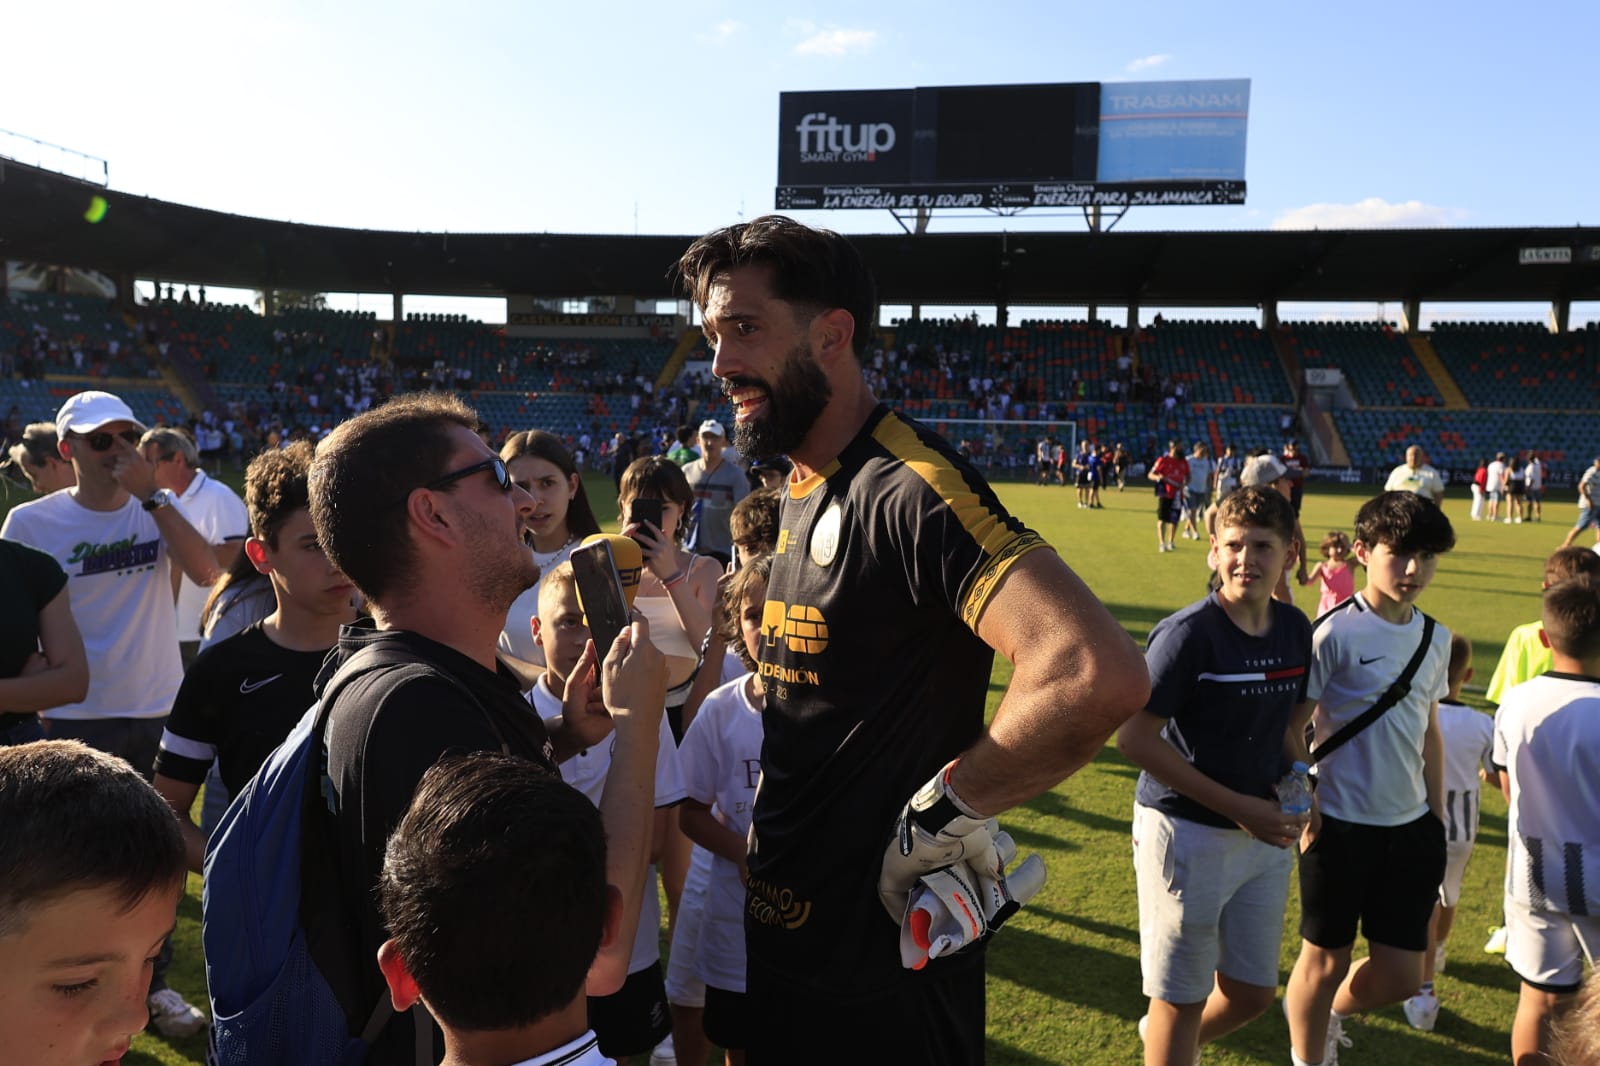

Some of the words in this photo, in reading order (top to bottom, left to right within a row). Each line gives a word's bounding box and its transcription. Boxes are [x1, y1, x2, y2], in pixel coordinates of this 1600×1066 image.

[1109, 93, 1241, 111] TRASANAM
[796, 112, 896, 153] fitup
[800, 151, 840, 163] SMART
[842, 151, 868, 162] GYM
[823, 195, 841, 209] LA
[841, 191, 896, 209] ENERGÍA
[898, 194, 917, 208] DE
[917, 194, 935, 207] TU
[935, 192, 984, 207] EQUIPO
[1033, 191, 1091, 206] ENERGÍA
[1092, 191, 1129, 205] PARA
[1131, 189, 1214, 205] SALAMANCA
[1245, 656, 1283, 667] TOMMY
